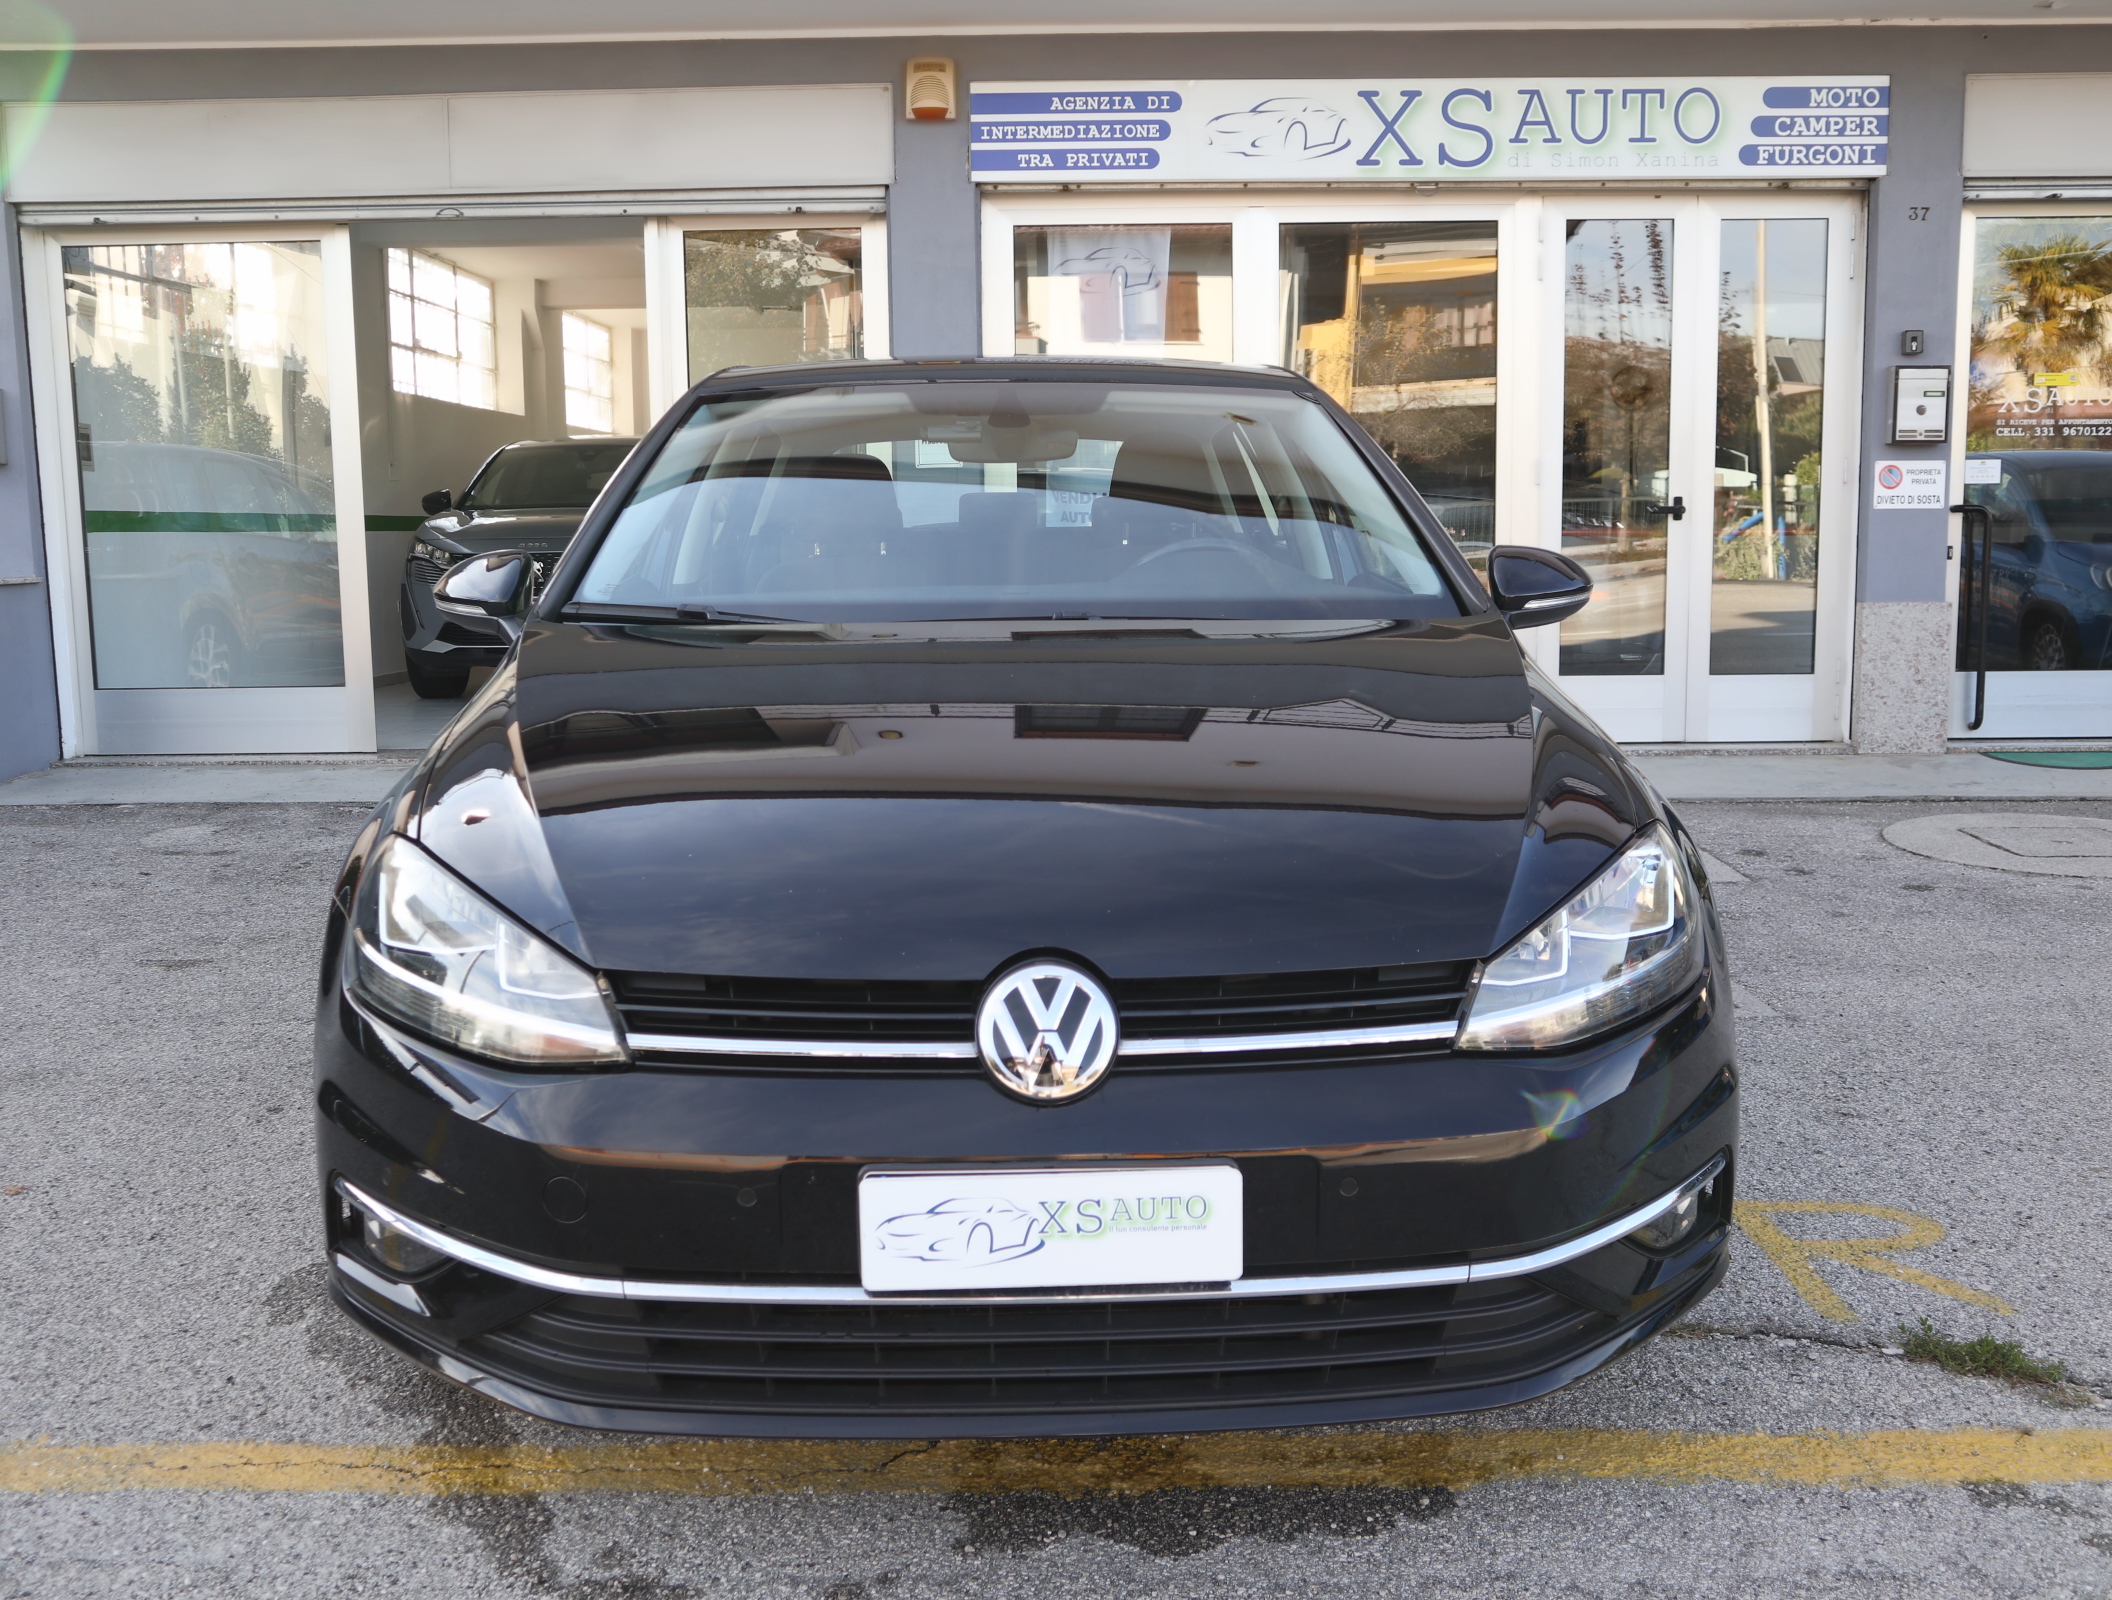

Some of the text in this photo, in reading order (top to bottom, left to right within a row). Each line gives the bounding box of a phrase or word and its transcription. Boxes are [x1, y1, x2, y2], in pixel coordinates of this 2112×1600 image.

[1050, 95, 1171, 111] AGENZIA DI
[1808, 88, 1881, 107] MOTO
[980, 123, 1160, 141] INTERMEDIAZIONE
[1773, 116, 1880, 136] CAMPER
[1017, 151, 1149, 168] TRA PRIVATI
[1507, 151, 1720, 168] di Simon Xanina
[1756, 145, 1877, 165] FURGONI
[1909, 206, 1931, 221] 37
[1996, 426, 2112, 436] CELL. 331 9670122
[1877, 494, 1941, 505] DIVIETO DI SOSTA
[1061, 510, 1092, 524] AUT
[1129, 1225, 1169, 1233] consulente
[1171, 1223, 1208, 1233] personale
